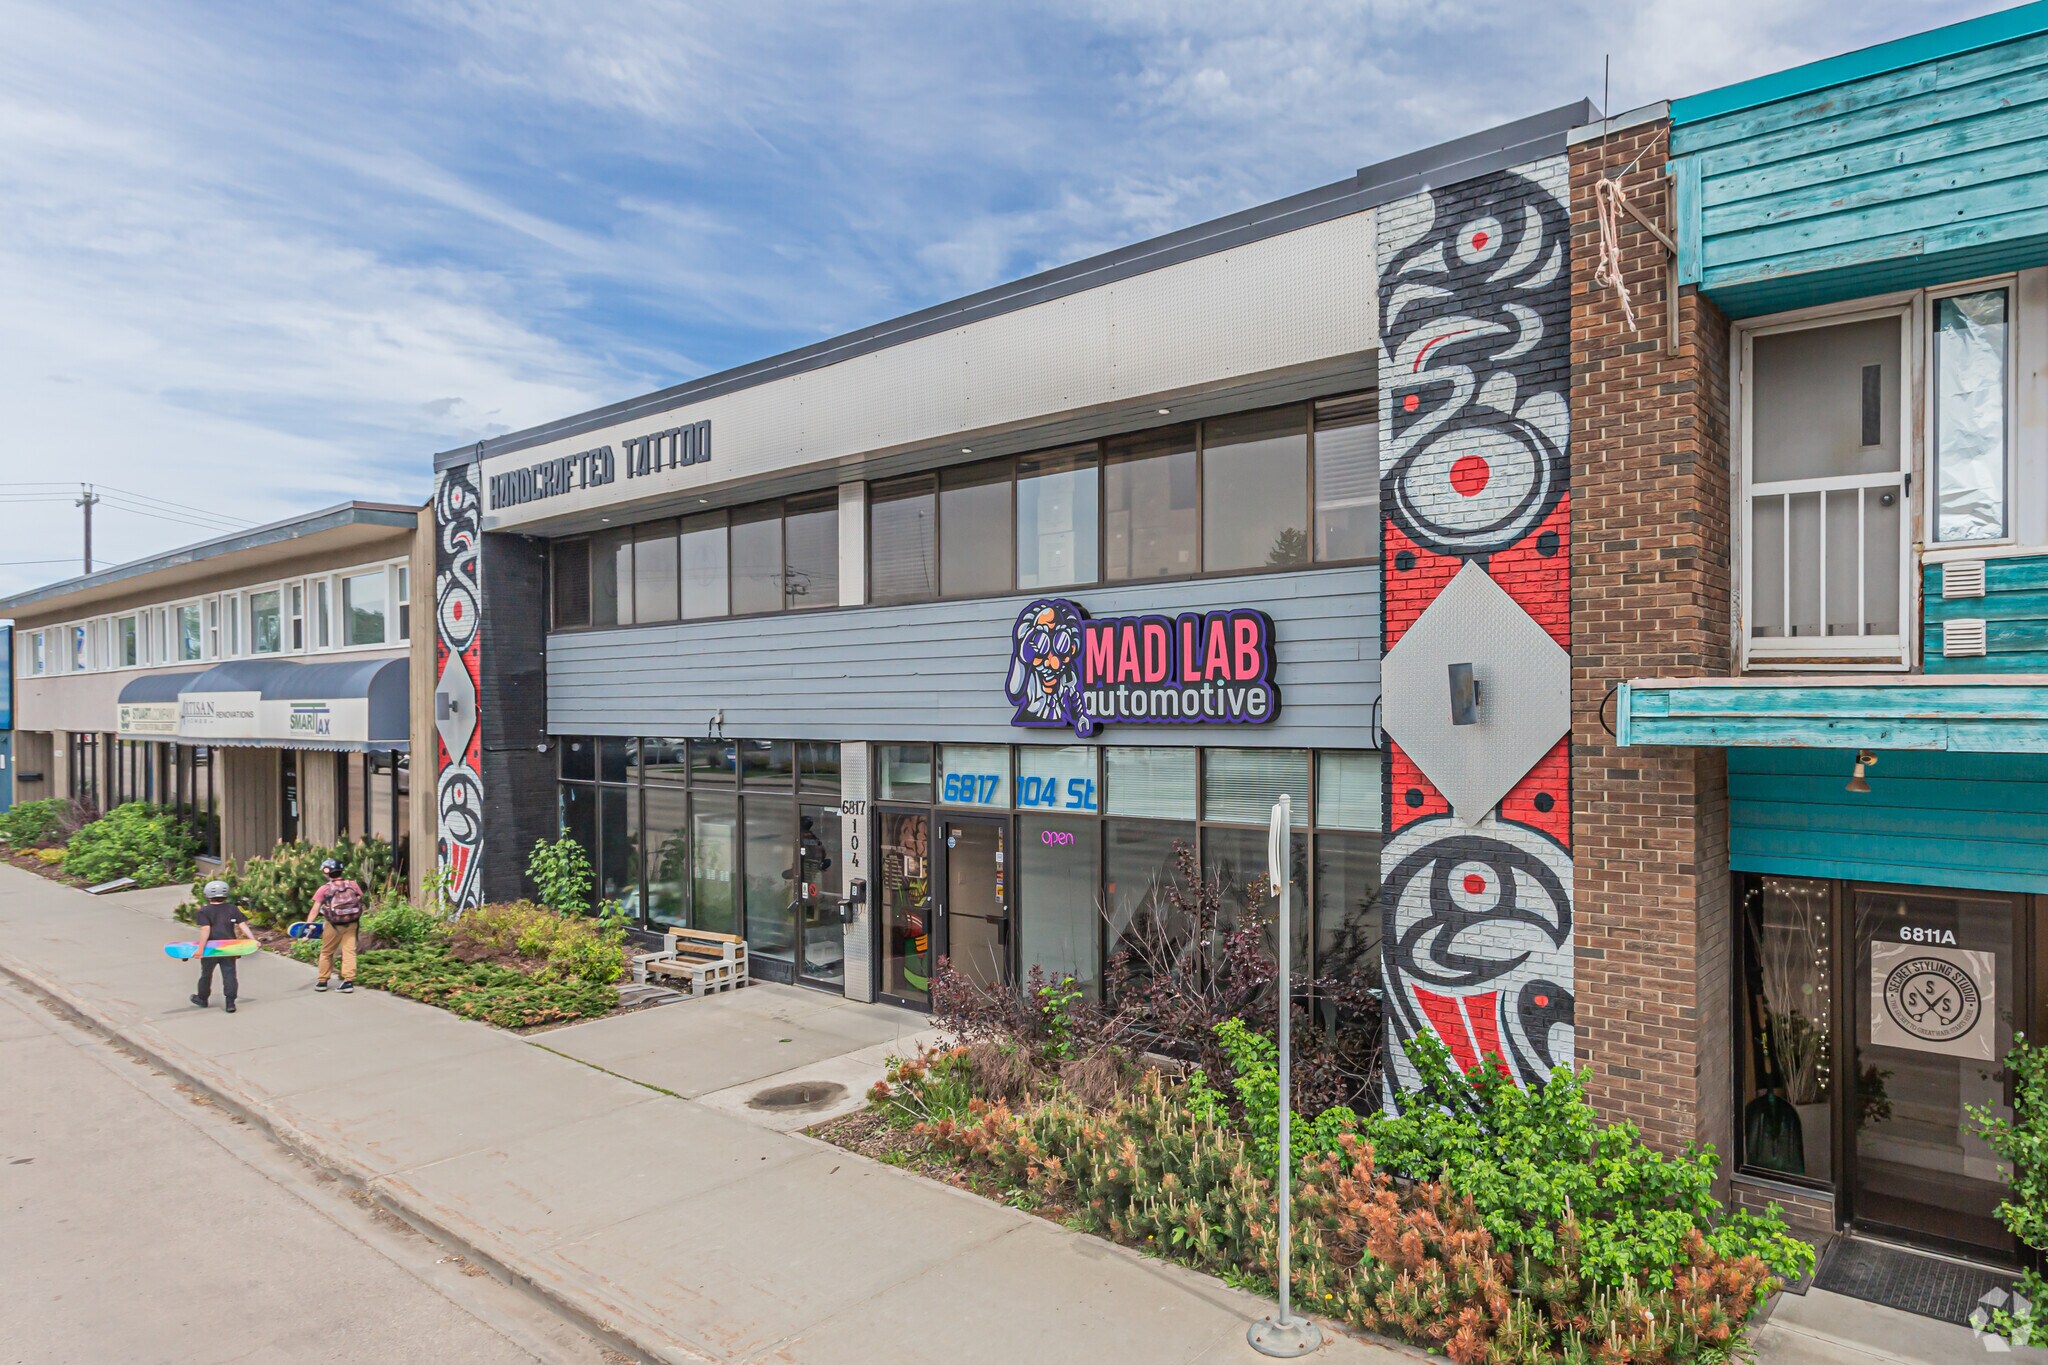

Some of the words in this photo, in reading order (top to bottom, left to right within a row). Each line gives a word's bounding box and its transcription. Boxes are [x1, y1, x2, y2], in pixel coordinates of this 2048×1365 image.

[490, 445, 615, 510] HANDCRAFTED
[622, 419, 712, 479] TATTOO
[1086, 624, 1167, 684] MAD
[1184, 618, 1260, 681] LAB
[216, 710, 255, 719] RENOVATIONS
[1084, 680, 1266, 716] automotive
[842, 799, 867, 816] 6817
[944, 773, 1000, 804] 6817
[1016, 776, 1056, 807] 104
[1066, 778, 1098, 811] St
[1041, 829, 1075, 848] open
[1900, 926, 1956, 944] 6811A
[1888, 965, 1913, 993] SECRET
[1912, 961, 1953, 976] STYLING
[1952, 971, 1977, 1003] STUDIO
